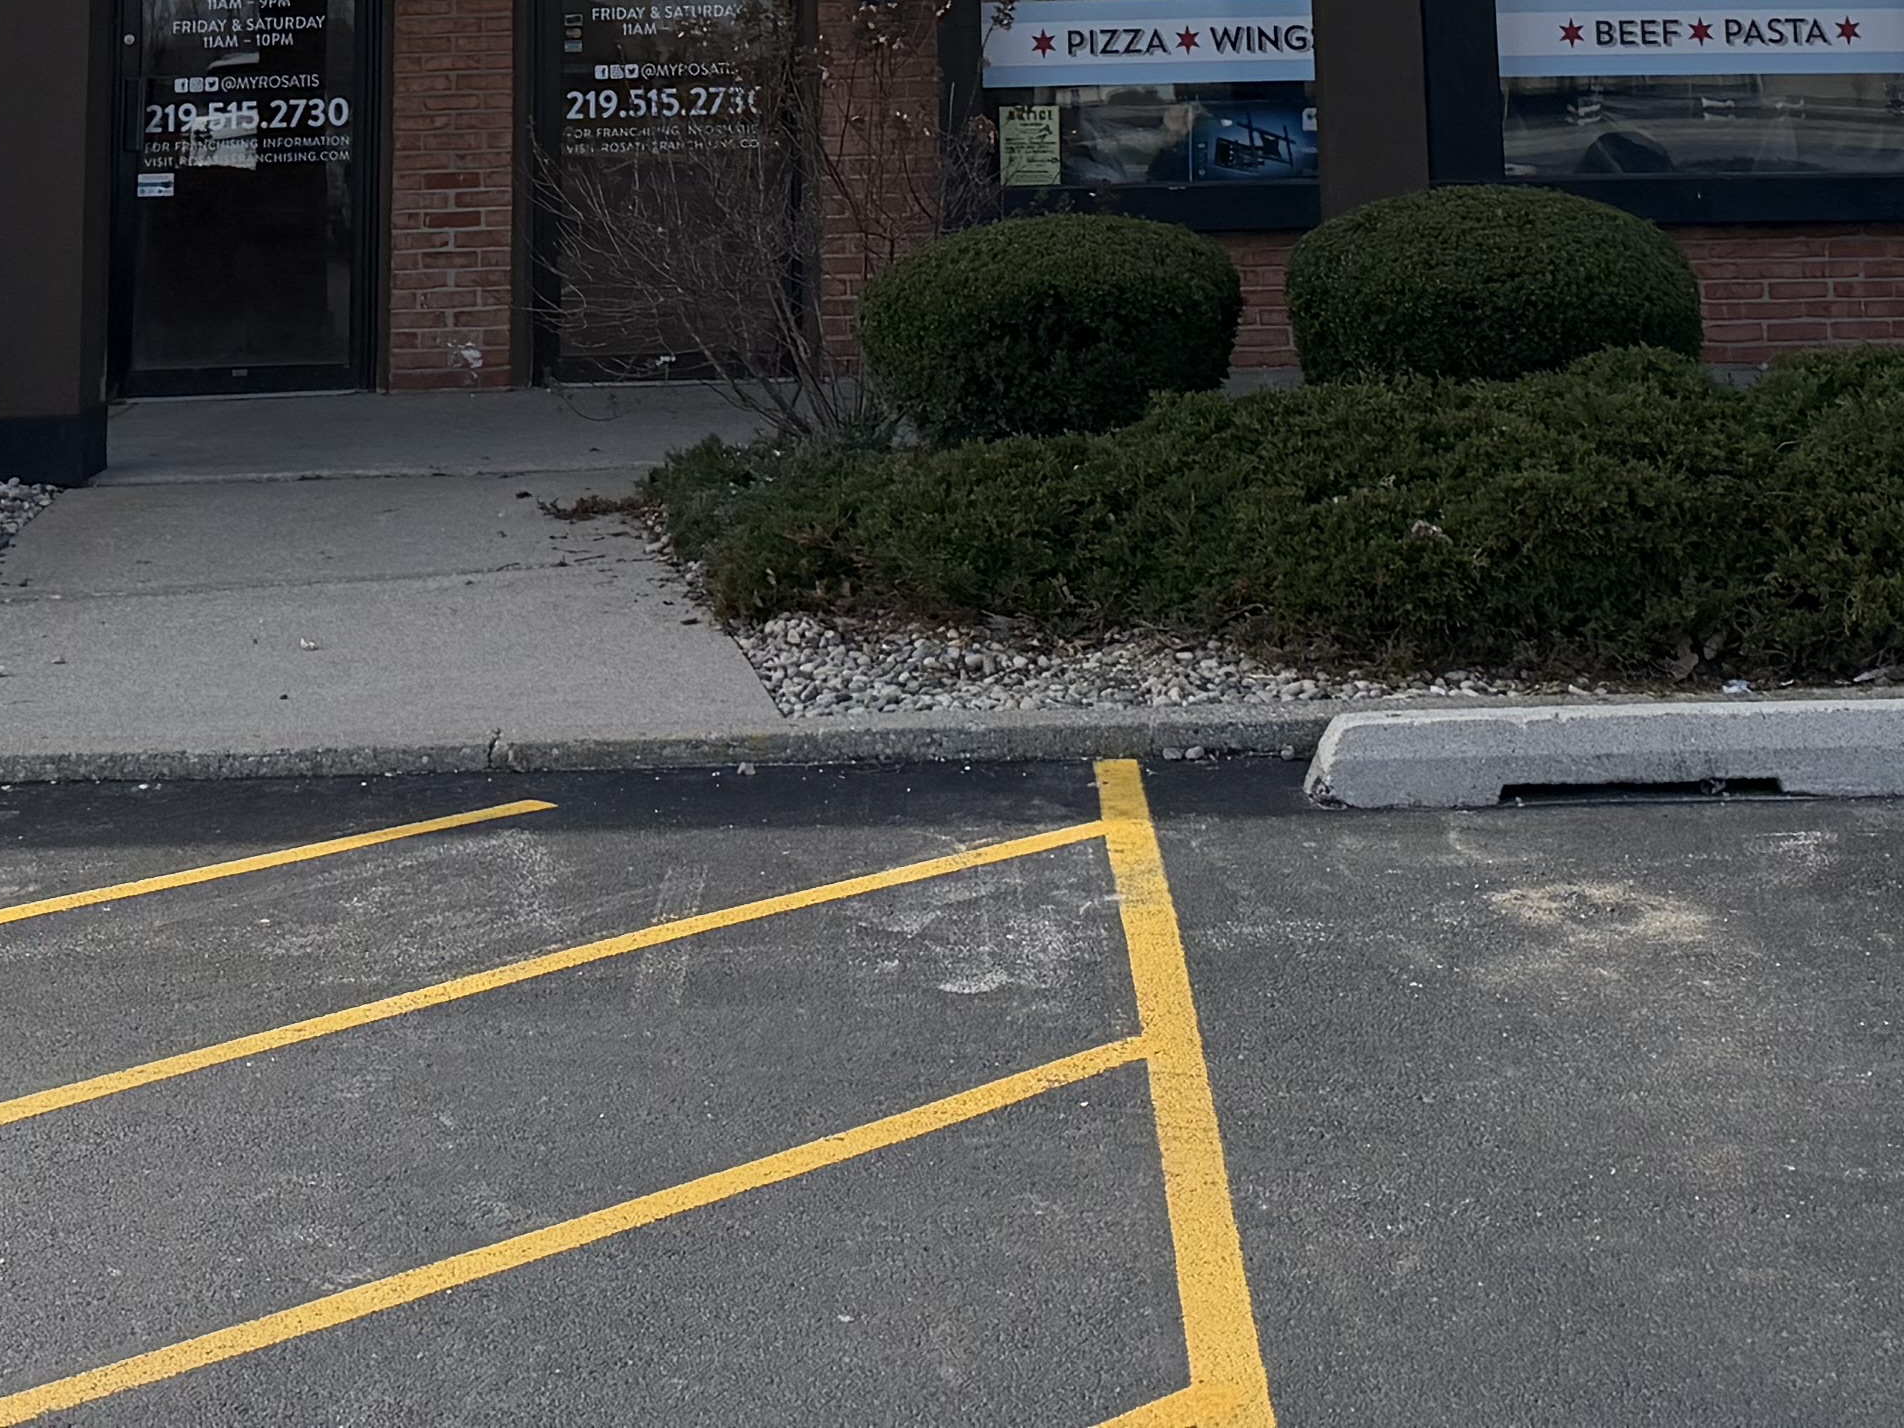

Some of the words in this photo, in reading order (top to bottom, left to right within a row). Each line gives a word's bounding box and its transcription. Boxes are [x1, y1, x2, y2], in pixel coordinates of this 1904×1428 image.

[592, 6, 645, 21] FRIDAY
[650, 6, 660, 19] &
[172, 20, 227, 35] FRIDAY
[232, 19, 242, 32] &
[246, 15, 326, 31] SATURDAY
[623, 22, 657, 36] 11AM
[1595, 19, 1683, 47] BEEF
[1725, 17, 1833, 46] PASTA
[203, 35, 239, 49] 11AM
[256, 32, 294, 47] 10PM
[1067, 28, 1171, 57] PIZZA
[1209, 24, 1314, 54] WING
[641, 61, 738, 81] @MYROSATI
[220, 74, 320, 91] @MYROSATIS
[145, 97, 350, 134] 219.515.2730
[145, 141, 170, 155] FOR
[263, 134, 350, 149] INFORMATION
[144, 157, 172, 169] VISIT
